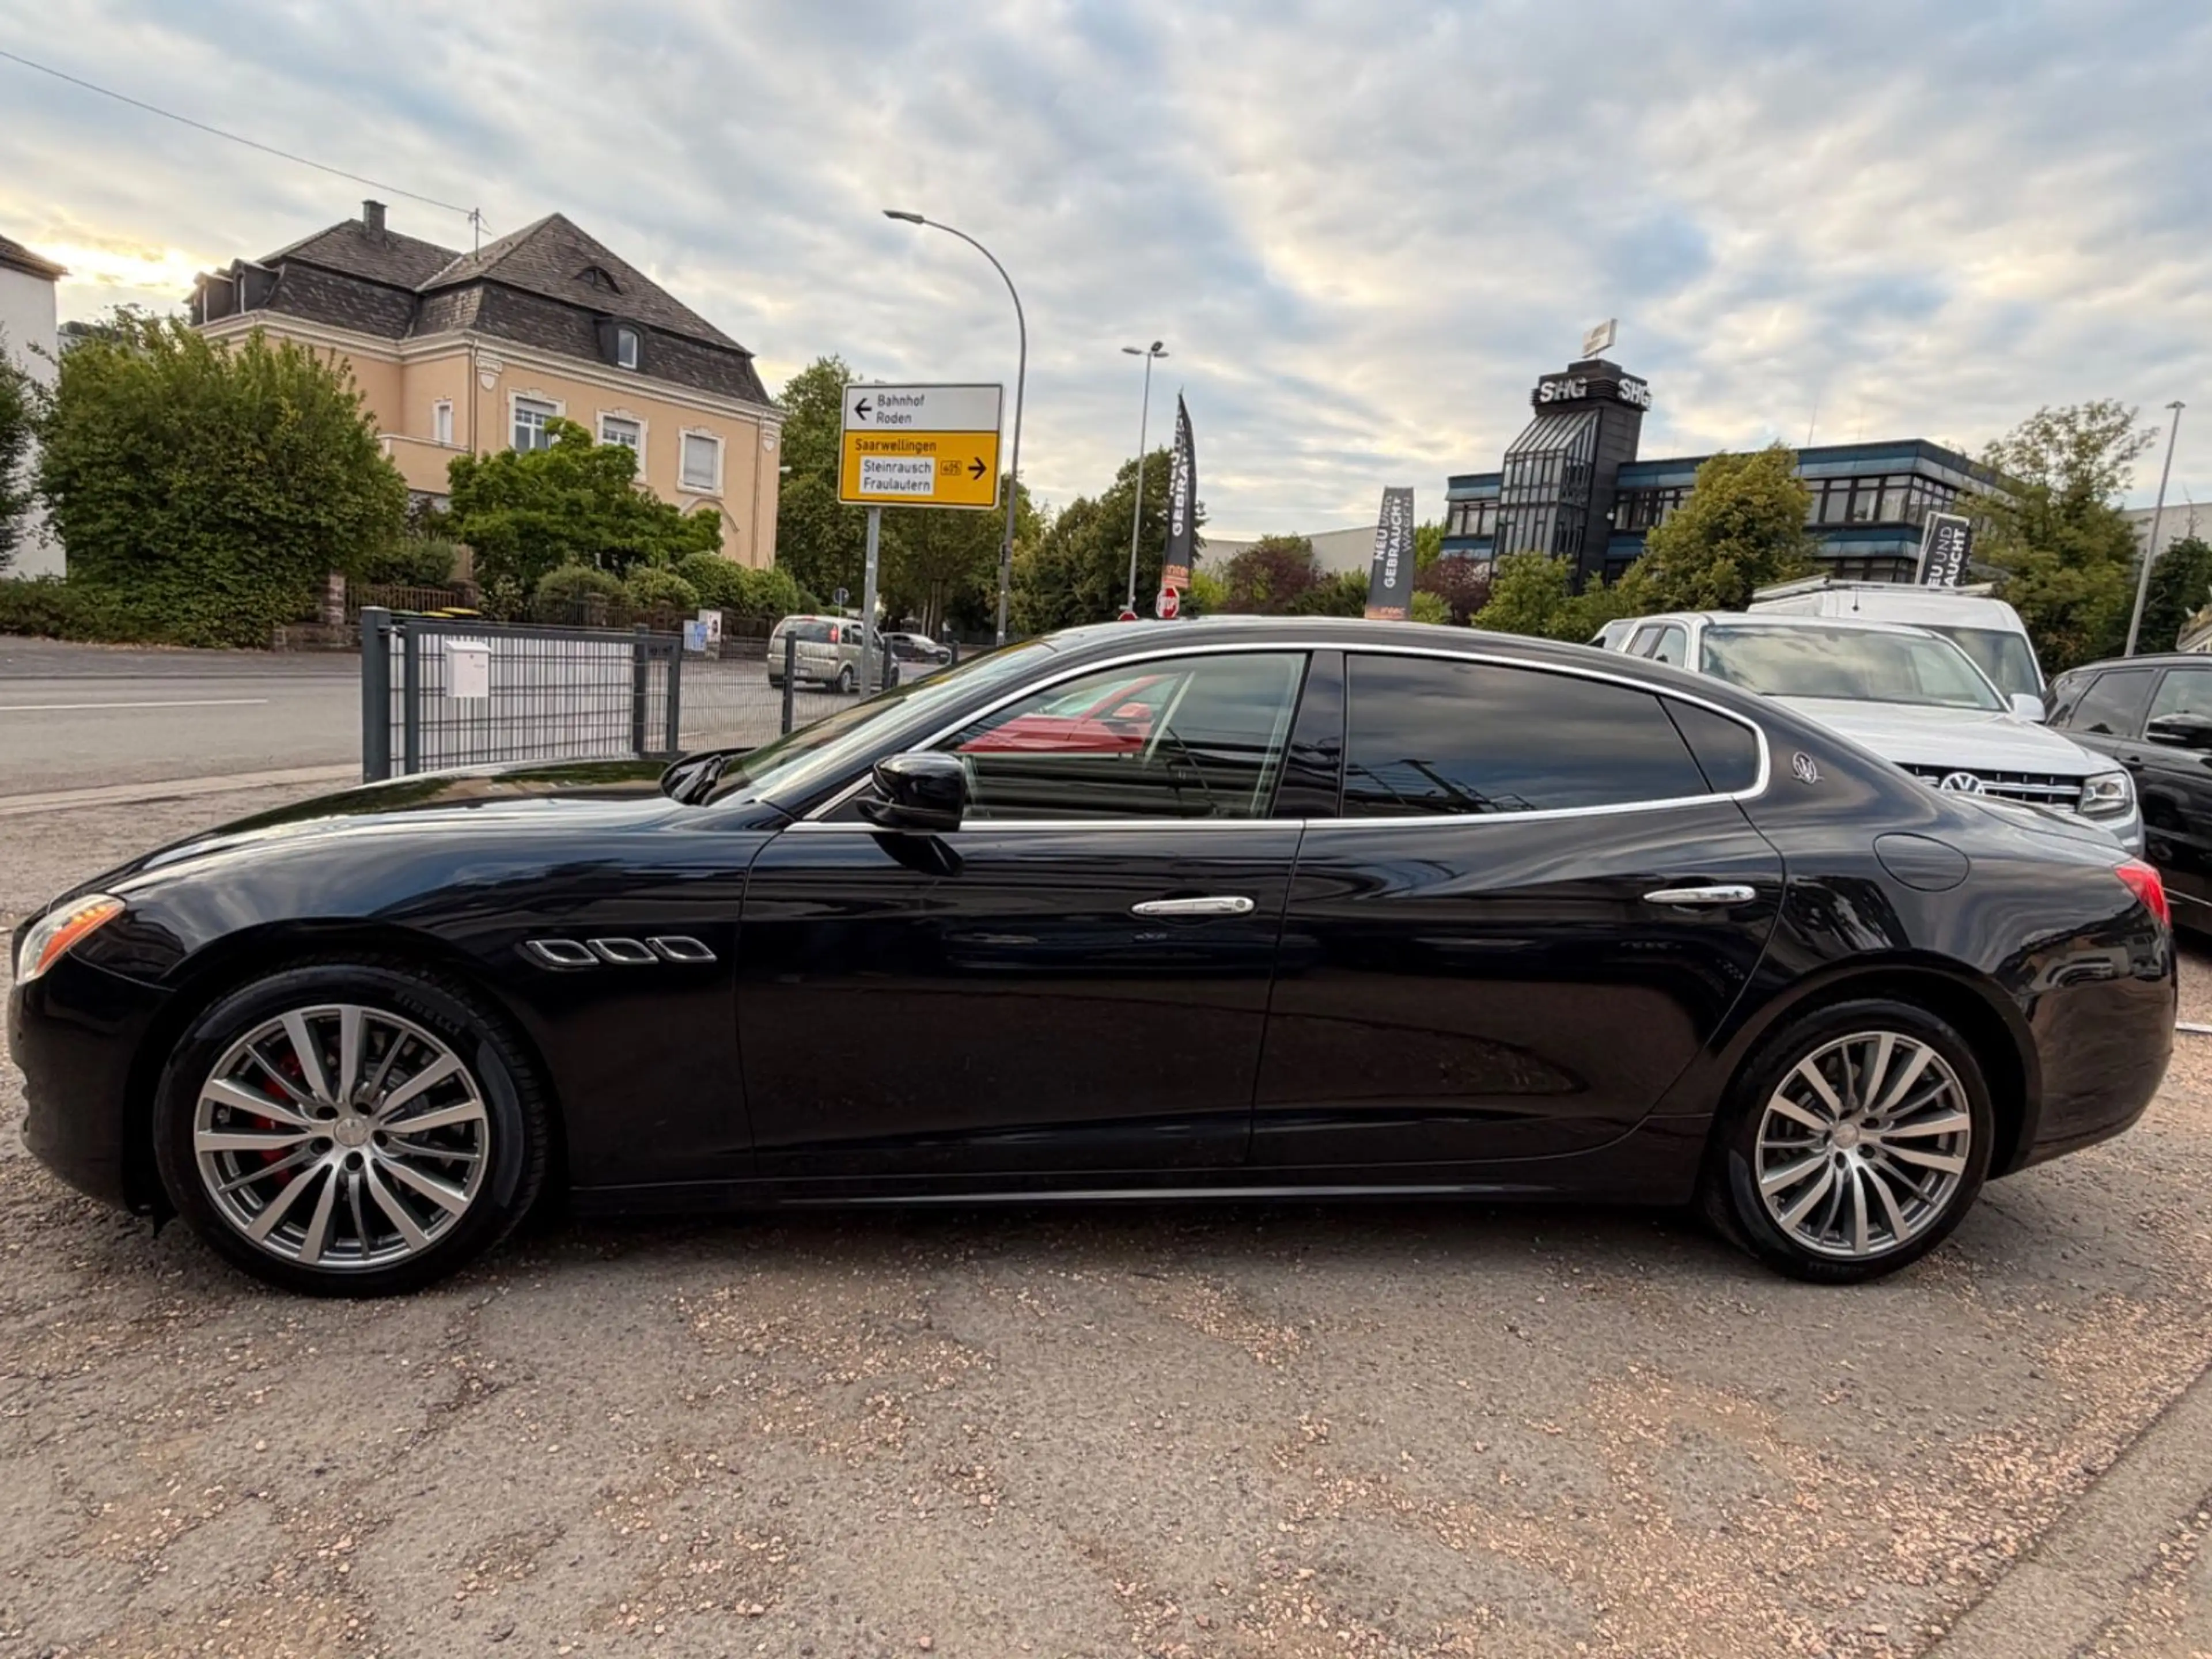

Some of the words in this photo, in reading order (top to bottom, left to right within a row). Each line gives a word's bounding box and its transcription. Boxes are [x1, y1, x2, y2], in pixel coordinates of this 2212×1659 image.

[877, 393, 925, 407] Bahnhof
[1539, 377, 1587, 403] SHG
[876, 411, 912, 424] Roden
[855, 438, 937, 454] Saarwellingen
[863, 459, 931, 474] Steinrausch
[863, 476, 930, 491] Fraulautern
[1373, 528, 1388, 561] NEU
[1384, 495, 1402, 588] GEBRAUCHT
[1934, 526, 1952, 563] UND
[1944, 528, 1966, 588] AUCHT
